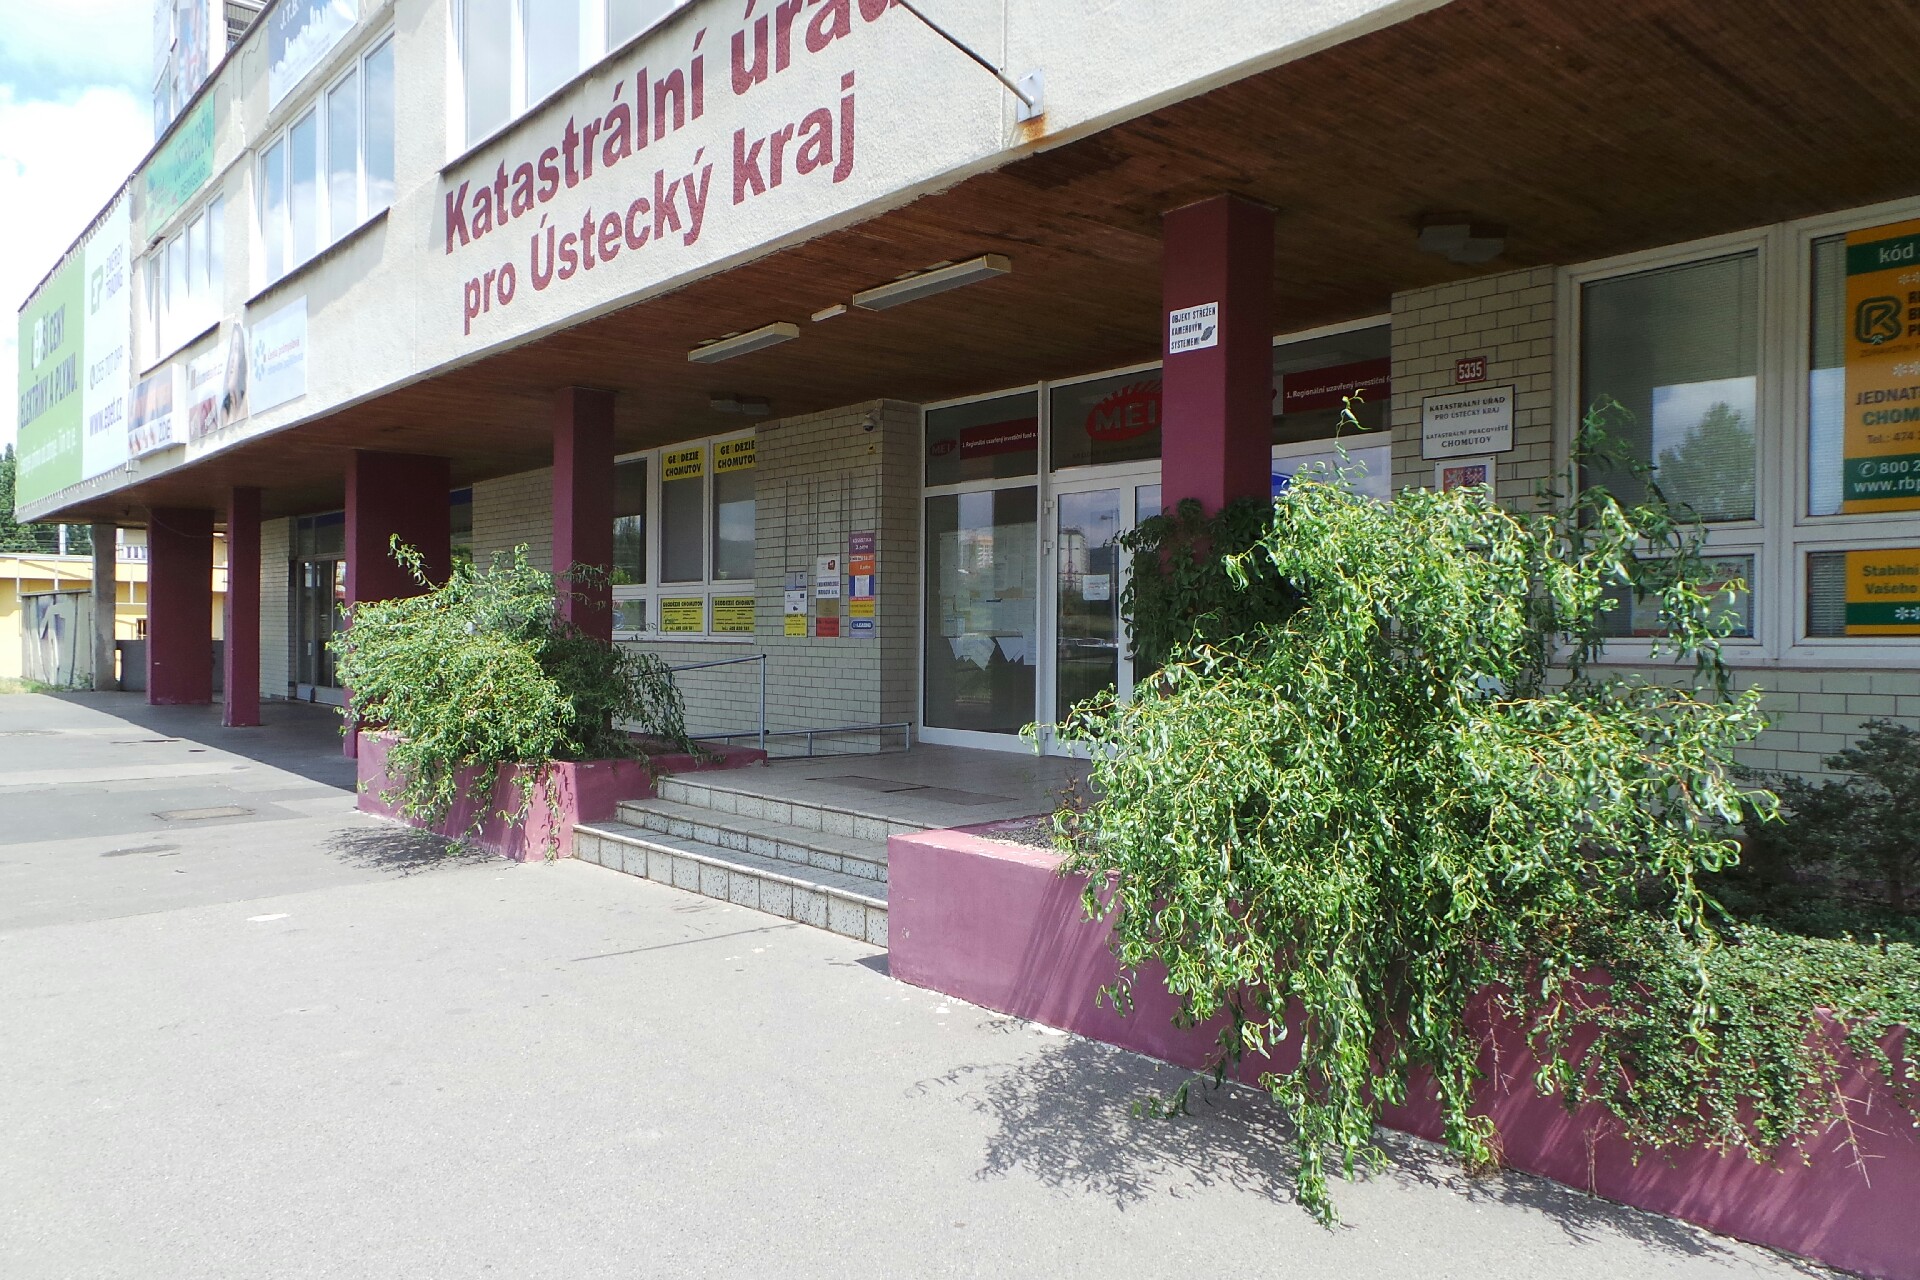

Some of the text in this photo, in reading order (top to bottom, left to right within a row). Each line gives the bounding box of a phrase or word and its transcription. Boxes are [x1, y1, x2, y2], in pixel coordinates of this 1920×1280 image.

[445, 0, 900, 255] Katastrální úřa
[464, 70, 855, 336] pro Ústecký kraj
[1879, 242, 1914, 264] kód
[1171, 306, 1216, 324] OBJEKT STŘEŽEN
[1171, 321, 1202, 336] KAMEROVÝM
[1458, 361, 1483, 379] 5335
[1434, 413, 1449, 421] PRO
[1482, 407, 1500, 415] KRAJ
[1441, 436, 1492, 448] CHOMUTOV
[665, 463, 702, 477] CHOMUTOV
[1879, 460, 1909, 474] 800
[1865, 583, 1918, 594] Vašeho
